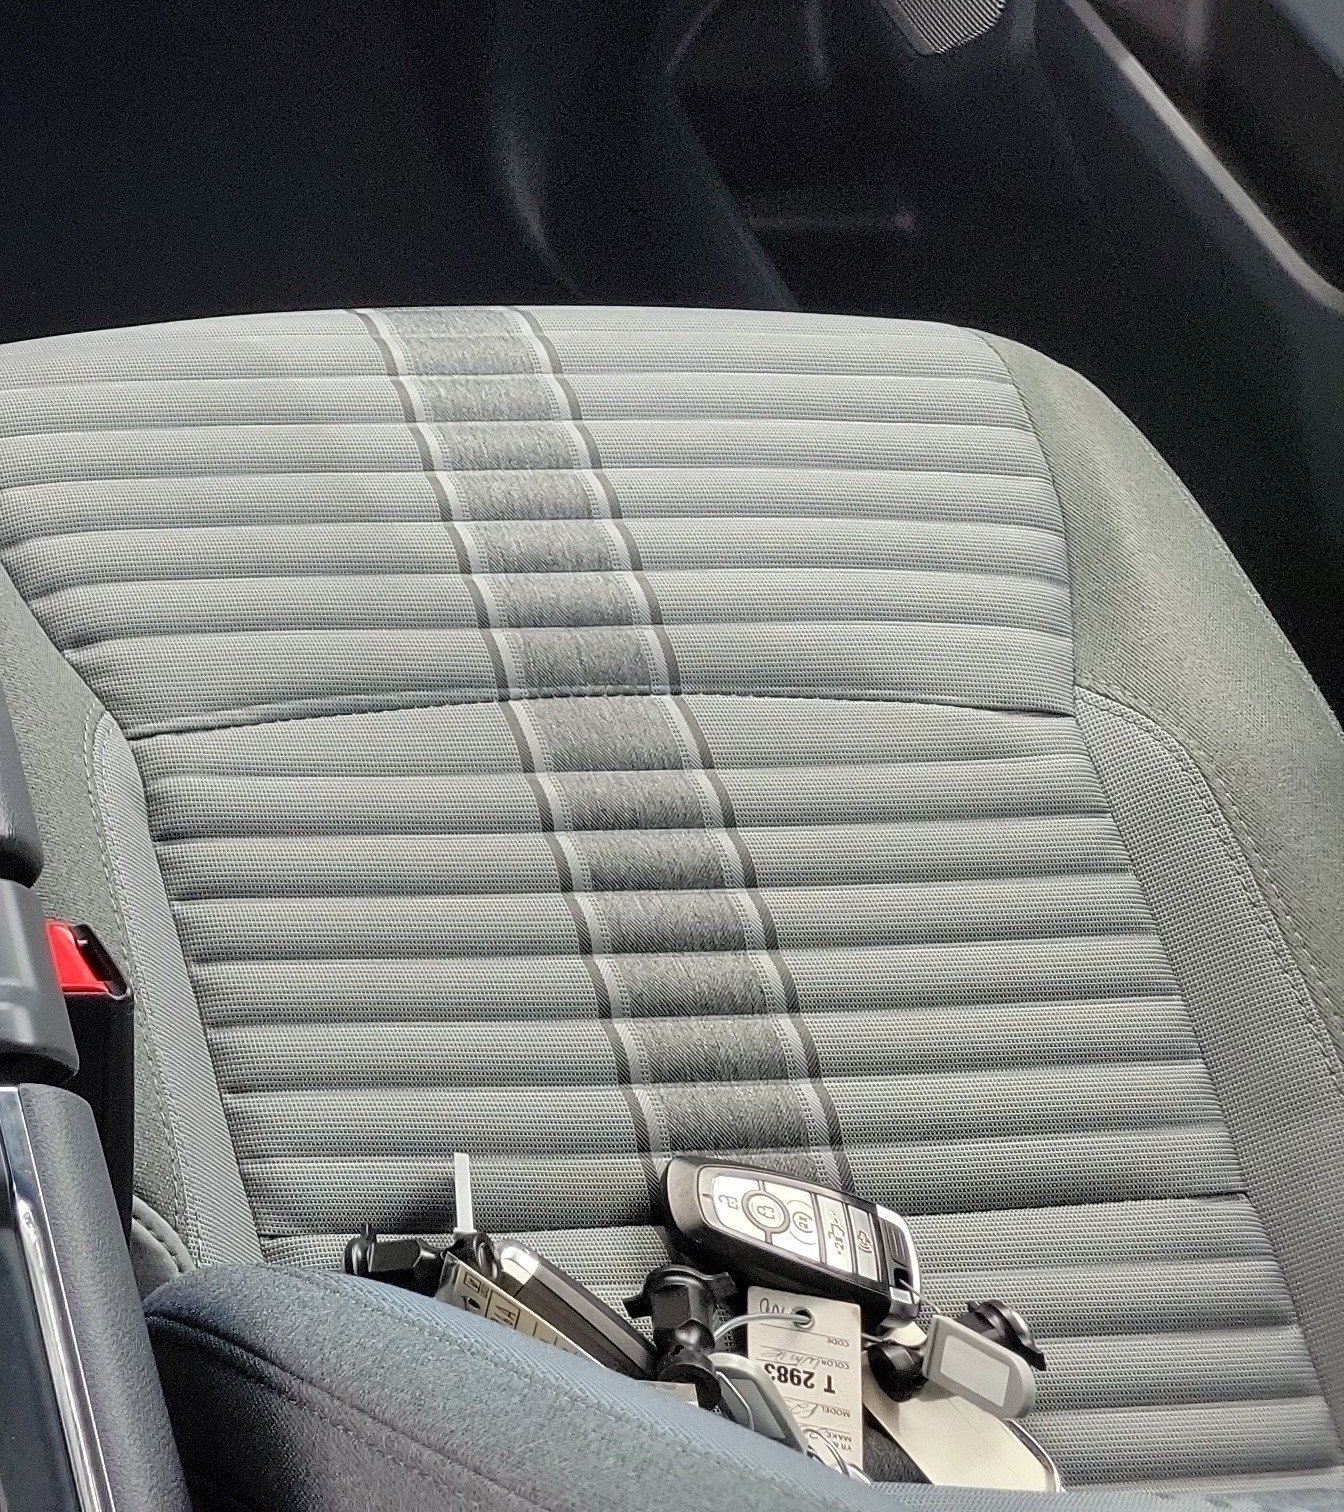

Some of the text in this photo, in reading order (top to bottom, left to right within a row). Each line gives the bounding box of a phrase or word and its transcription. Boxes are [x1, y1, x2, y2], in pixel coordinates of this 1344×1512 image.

[827, 1337, 850, 1347] CODE
[820, 1359, 850, 1370] COLOR
[824, 1374, 836, 1394] T
[822, 1405, 851, 1418] MODEL
